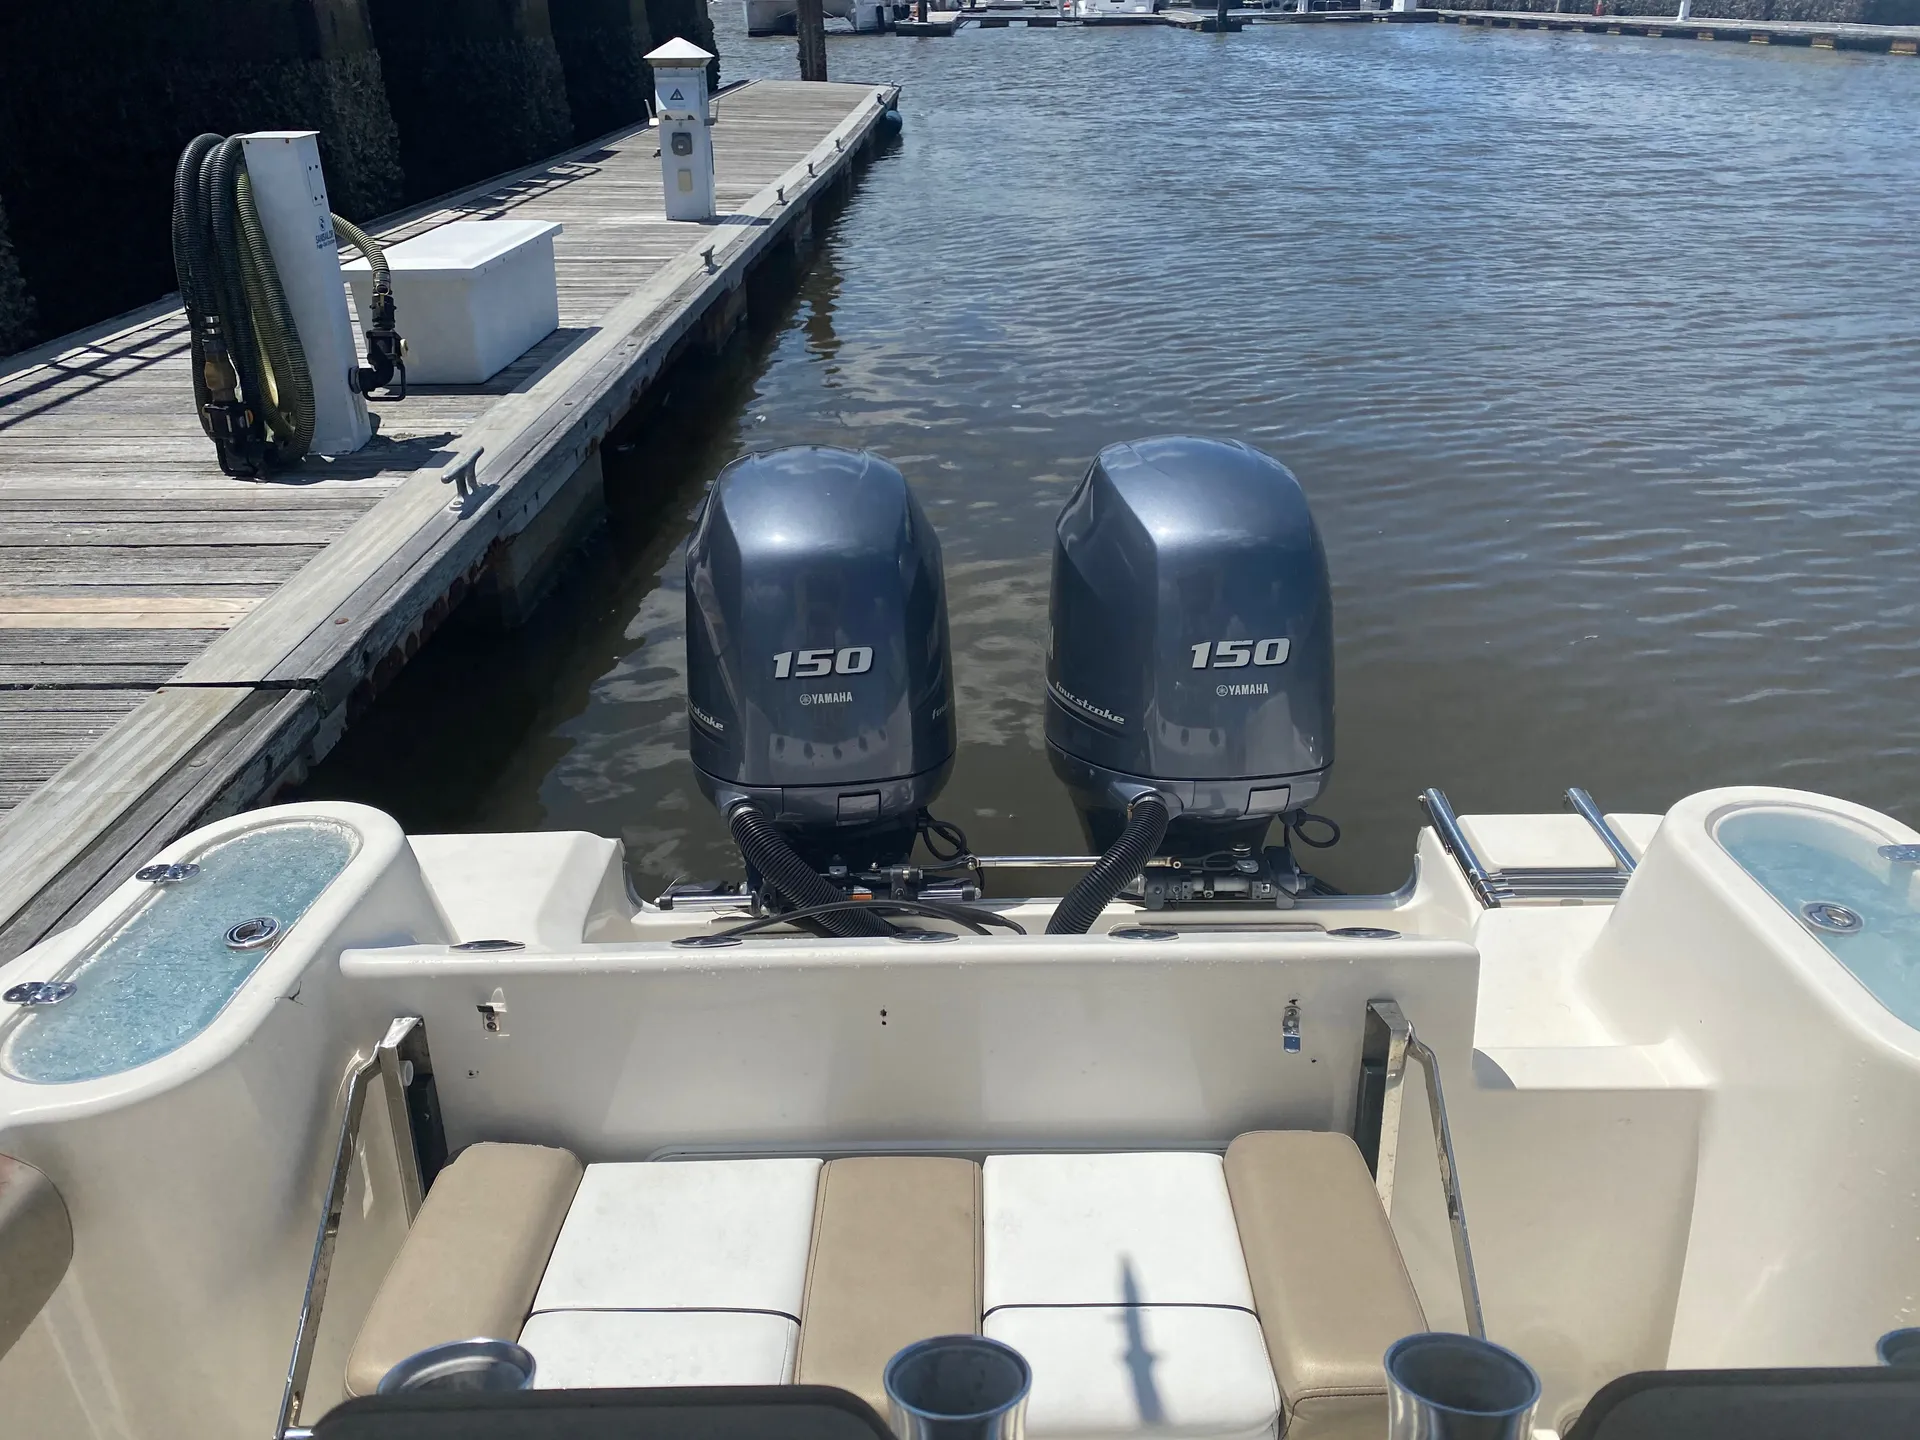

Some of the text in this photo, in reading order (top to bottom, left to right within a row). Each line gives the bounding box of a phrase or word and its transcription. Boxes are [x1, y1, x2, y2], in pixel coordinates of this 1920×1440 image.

[772, 646, 874, 679] 150
[1190, 637, 1291, 669] 150
[811, 691, 853, 704] YAMAHA
[1228, 683, 1269, 696] YAMAHA
